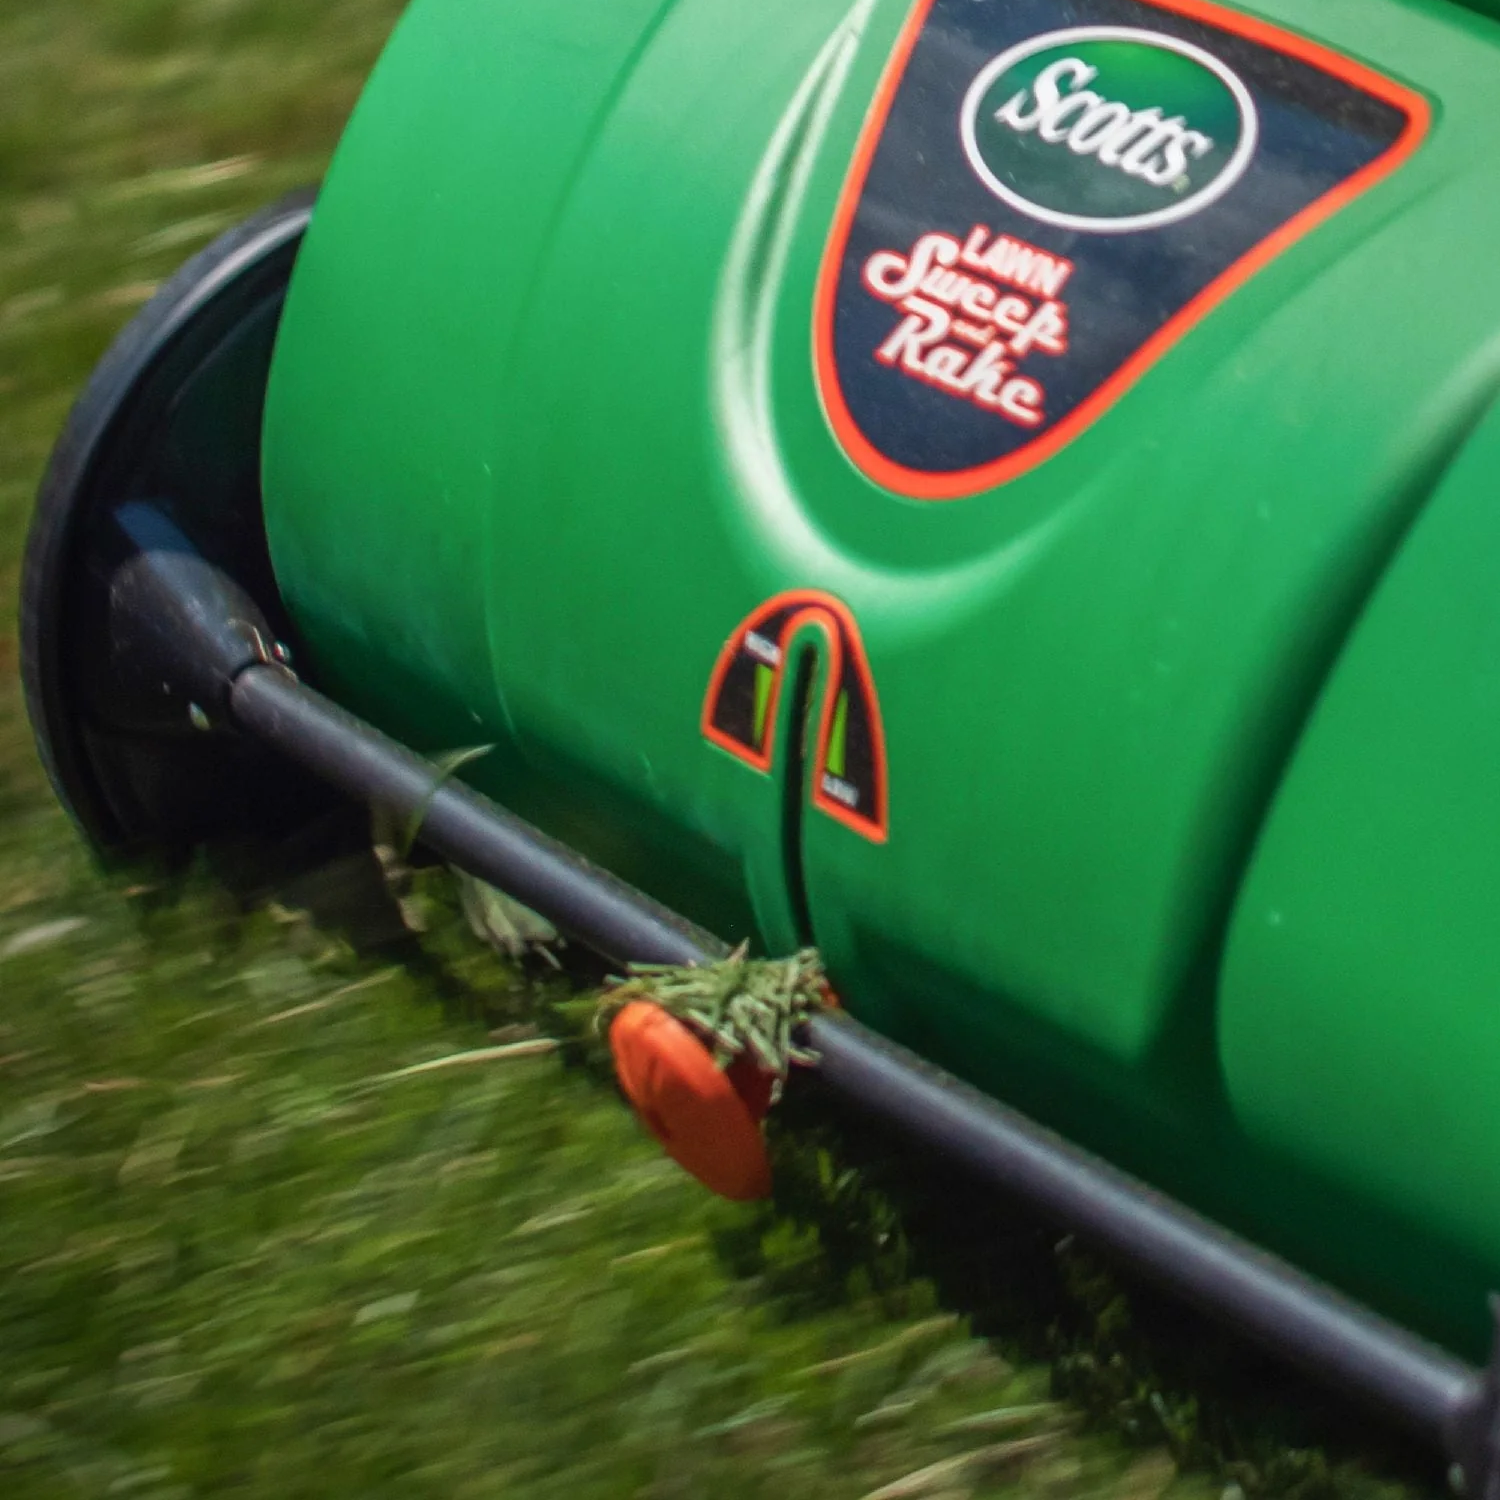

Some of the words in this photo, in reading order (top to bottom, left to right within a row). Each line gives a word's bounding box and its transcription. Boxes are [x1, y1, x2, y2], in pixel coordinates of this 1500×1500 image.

[994, 57, 1214, 186] Scotts
[863, 232, 1068, 354] Sweep
[960, 224, 1073, 298] LAWN
[879, 295, 1044, 424] Rake
